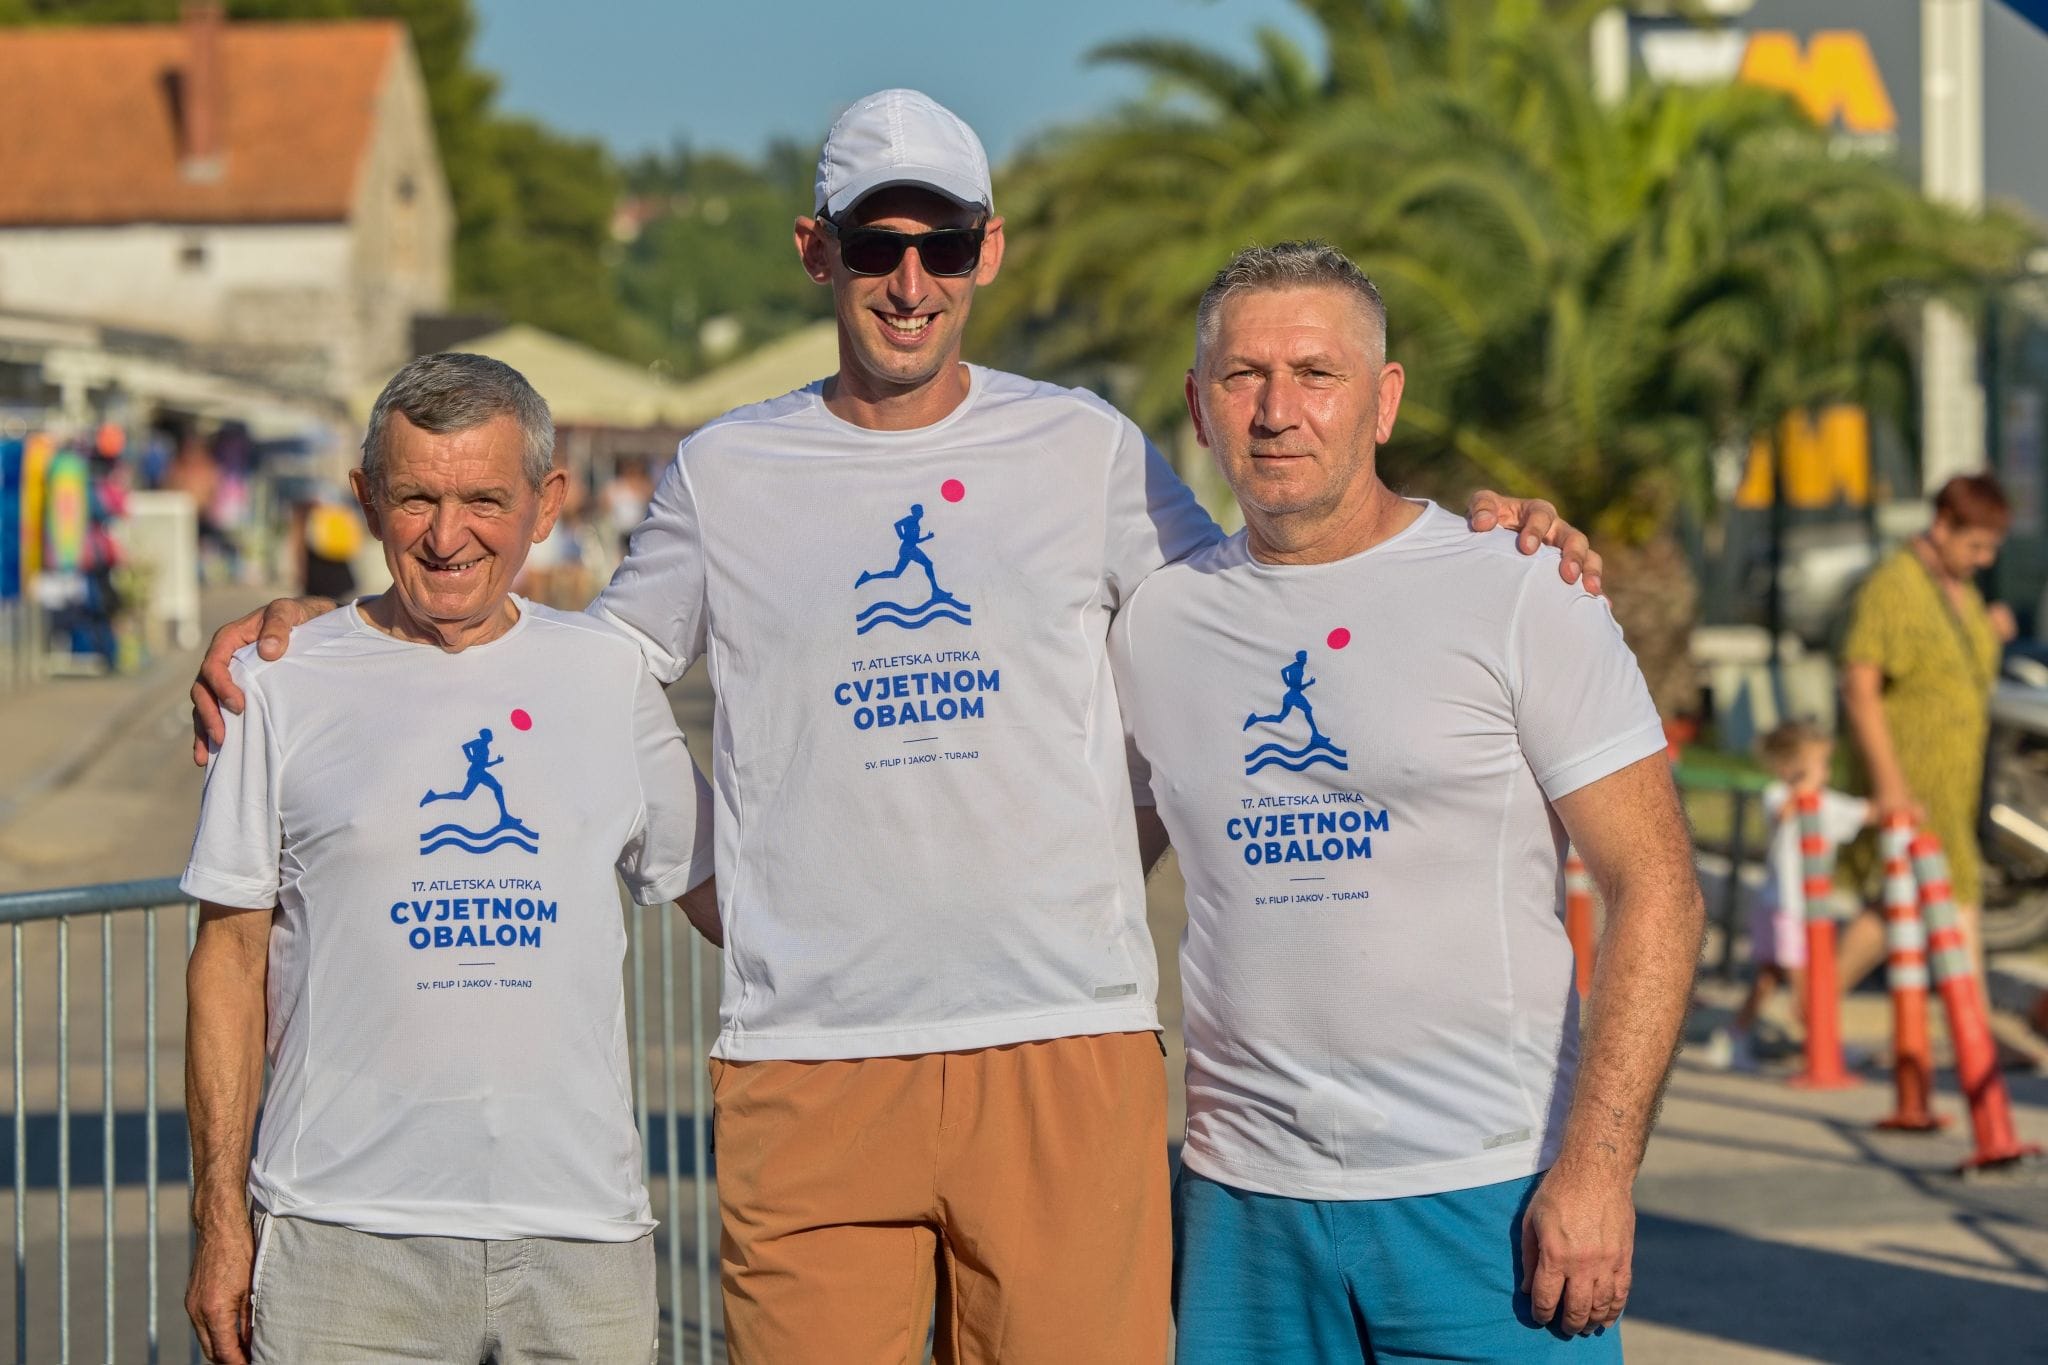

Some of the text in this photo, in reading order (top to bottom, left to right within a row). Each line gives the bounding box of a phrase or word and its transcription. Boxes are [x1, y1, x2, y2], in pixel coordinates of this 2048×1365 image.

[851, 651, 980, 672] 17. ATLETSKA UTRKA
[834, 669, 1000, 706] CVJETNOM
[853, 696, 984, 730] OBALOM
[864, 760, 878, 770] SV.
[880, 758, 901, 768] FILIP
[908, 753, 937, 765] JAKOV
[944, 750, 979, 760] TURANJ
[1240, 791, 1364, 809] 17. ATLETSKA UTRKA
[1226, 809, 1390, 841] CVJETNOM
[1244, 836, 1372, 866] OBALOM
[411, 878, 542, 892] 17. ATLETSKA UTRKA
[1255, 896, 1268, 905] SV.
[1269, 895, 1289, 904] FILIP
[1295, 893, 1324, 903] JAKOV
[1332, 890, 1369, 901] TURANJ
[390, 897, 558, 924] CVJETNOM
[408, 923, 541, 950] OBALOM
[416, 981, 431, 990] SV.
[432, 980, 455, 989] FILIP
[461, 979, 492, 988] JAKOV
[499, 979, 533, 988] TURANJ
